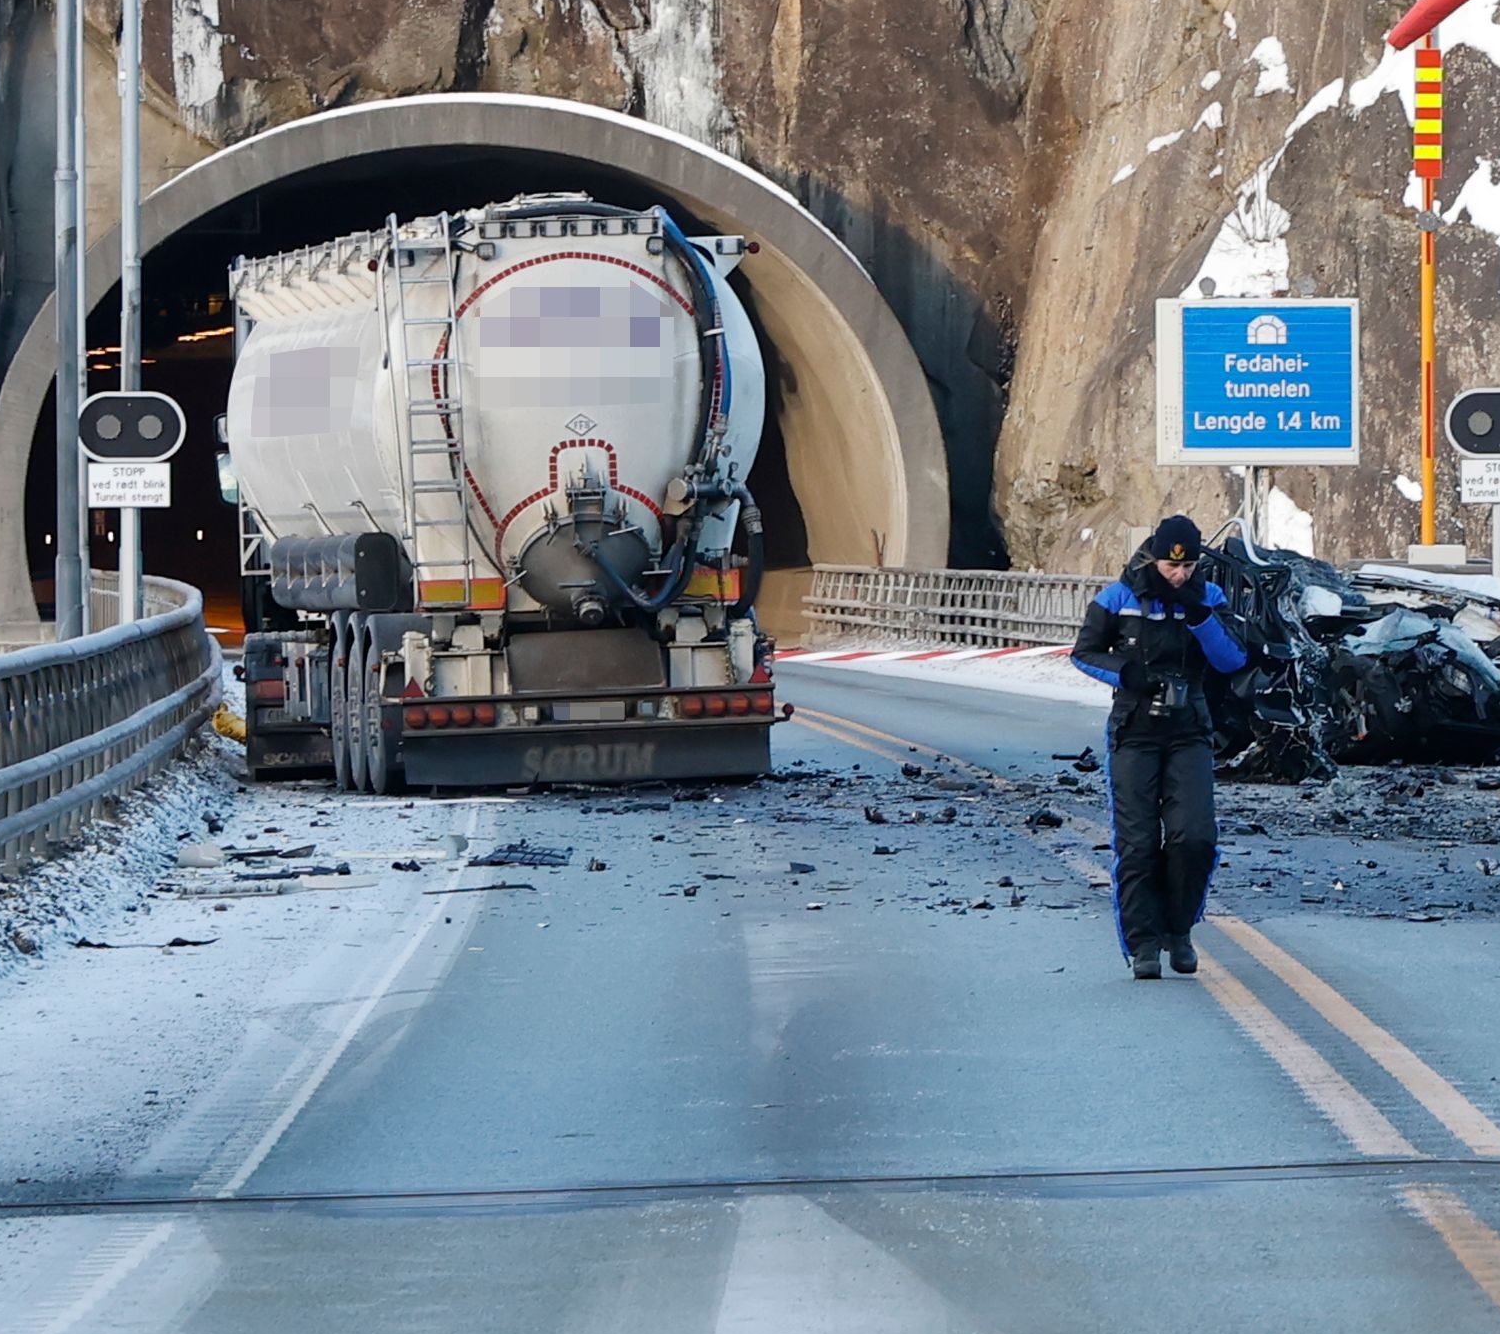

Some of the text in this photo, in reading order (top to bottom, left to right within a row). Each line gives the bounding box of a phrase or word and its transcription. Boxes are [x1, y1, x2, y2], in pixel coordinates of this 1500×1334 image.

[1224, 353, 1309, 373] Fedahei-
[1224, 379, 1310, 398] tunnelen
[1194, 411, 1341, 434] Lengde 1,4 km
[112, 467, 146, 477] STOPP
[92, 479, 166, 489] ved rødt blink
[1465, 476, 1484, 485] ved
[95, 492, 164, 503] Tunnel stengt
[1468, 488, 1499, 498] Tunnel
